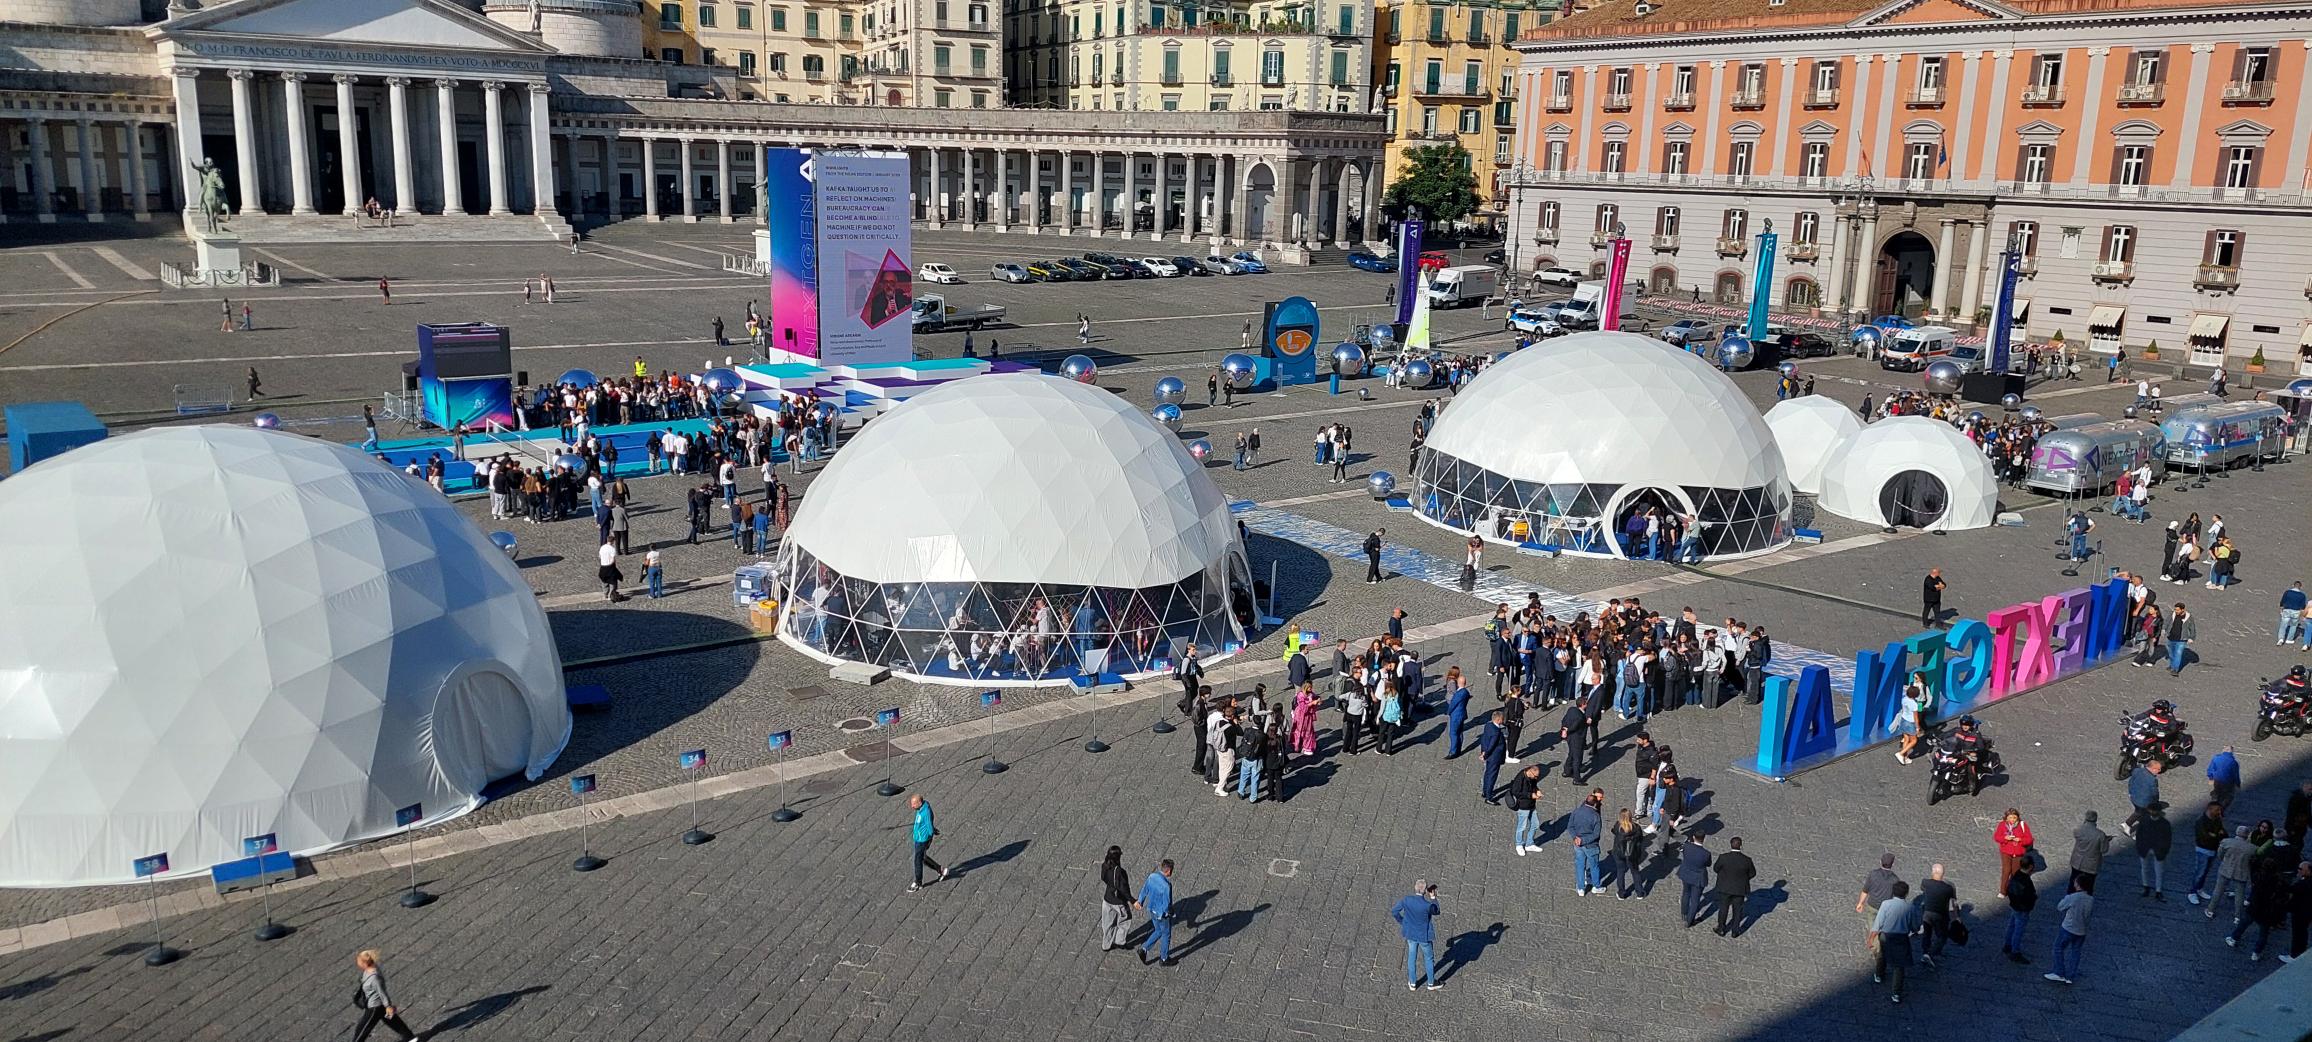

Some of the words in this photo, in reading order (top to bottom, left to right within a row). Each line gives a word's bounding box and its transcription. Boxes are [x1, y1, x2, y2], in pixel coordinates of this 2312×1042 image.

[233, 46, 297, 57] FRANCISCO
[450, 57, 478, 67] VOTO
[799, 194, 818, 357] NEXTGEN
[988, 694, 996, 702] 31
[885, 712, 894, 720] 32
[776, 735, 786, 744] 33
[688, 754, 700, 764] 34
[254, 839, 267, 850] 37
